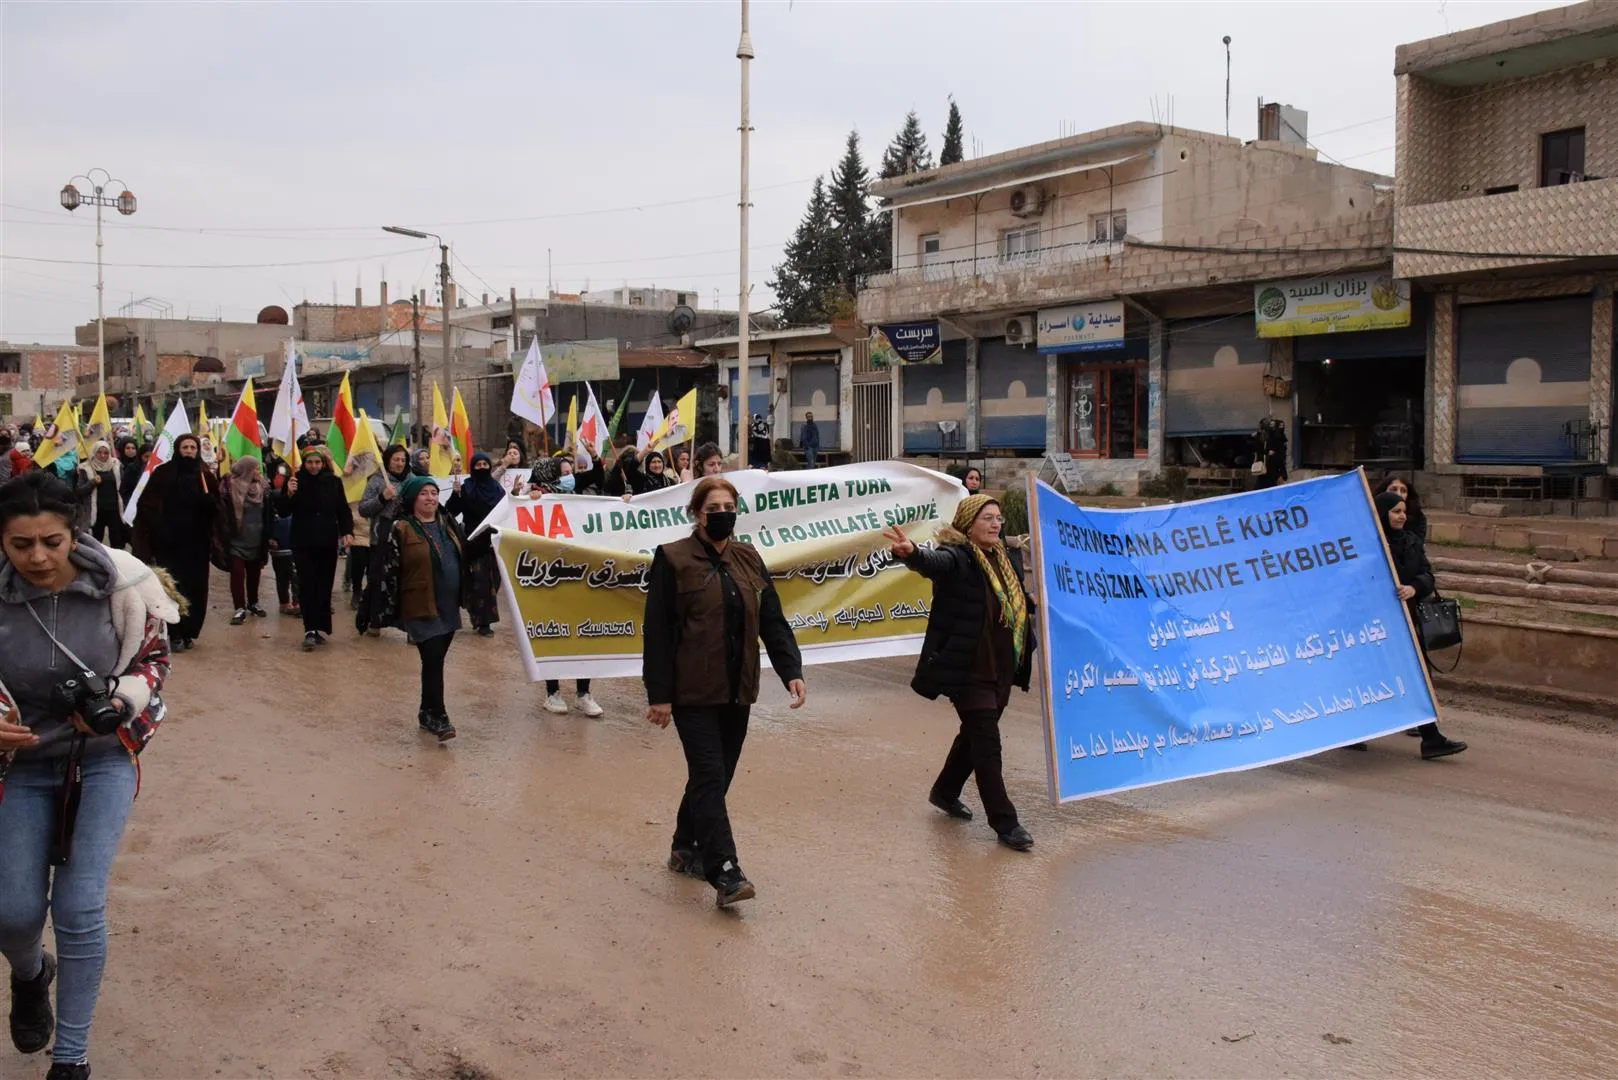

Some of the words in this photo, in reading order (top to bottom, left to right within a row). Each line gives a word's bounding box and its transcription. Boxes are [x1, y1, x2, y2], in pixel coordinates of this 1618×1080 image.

[1289, 281, 1329, 301] السيد
[1334, 278, 1367, 297] برزان
[895, 327, 933, 343] سربست
[1088, 312, 1121, 329] صيدلية
[516, 504, 573, 539] NA
[582, 512, 603, 534] JI
[755, 483, 839, 512] DEWLETA
[758, 526, 775, 547] Û
[778, 508, 881, 544] ROJHILATÊ
[884, 498, 939, 527] SÛRIYÊ
[1057, 519, 1168, 557] BERXWEDANA
[1171, 515, 1235, 552] GELÊ
[1238, 505, 1309, 540] KURD
[515, 550, 588, 587] سوريا
[1053, 560, 1076, 594] WÊ
[1076, 567, 1148, 603] FAŞÎZMA
[1146, 562, 1243, 598] TURKIYE
[1245, 536, 1358, 581] TÊKBIBE
[1148, 619, 1180, 651] الدولي
[1181, 612, 1220, 638] للصمت
[1220, 610, 1234, 631] لا
[1359, 618, 1388, 646] تجاه
[1295, 629, 1340, 664] ترتكبه
[1341, 628, 1355, 649] ما
[1195, 654, 1242, 686] التركية
[1241, 644, 1290, 675] الفاشية
[1065, 661, 1099, 699] الكردي
